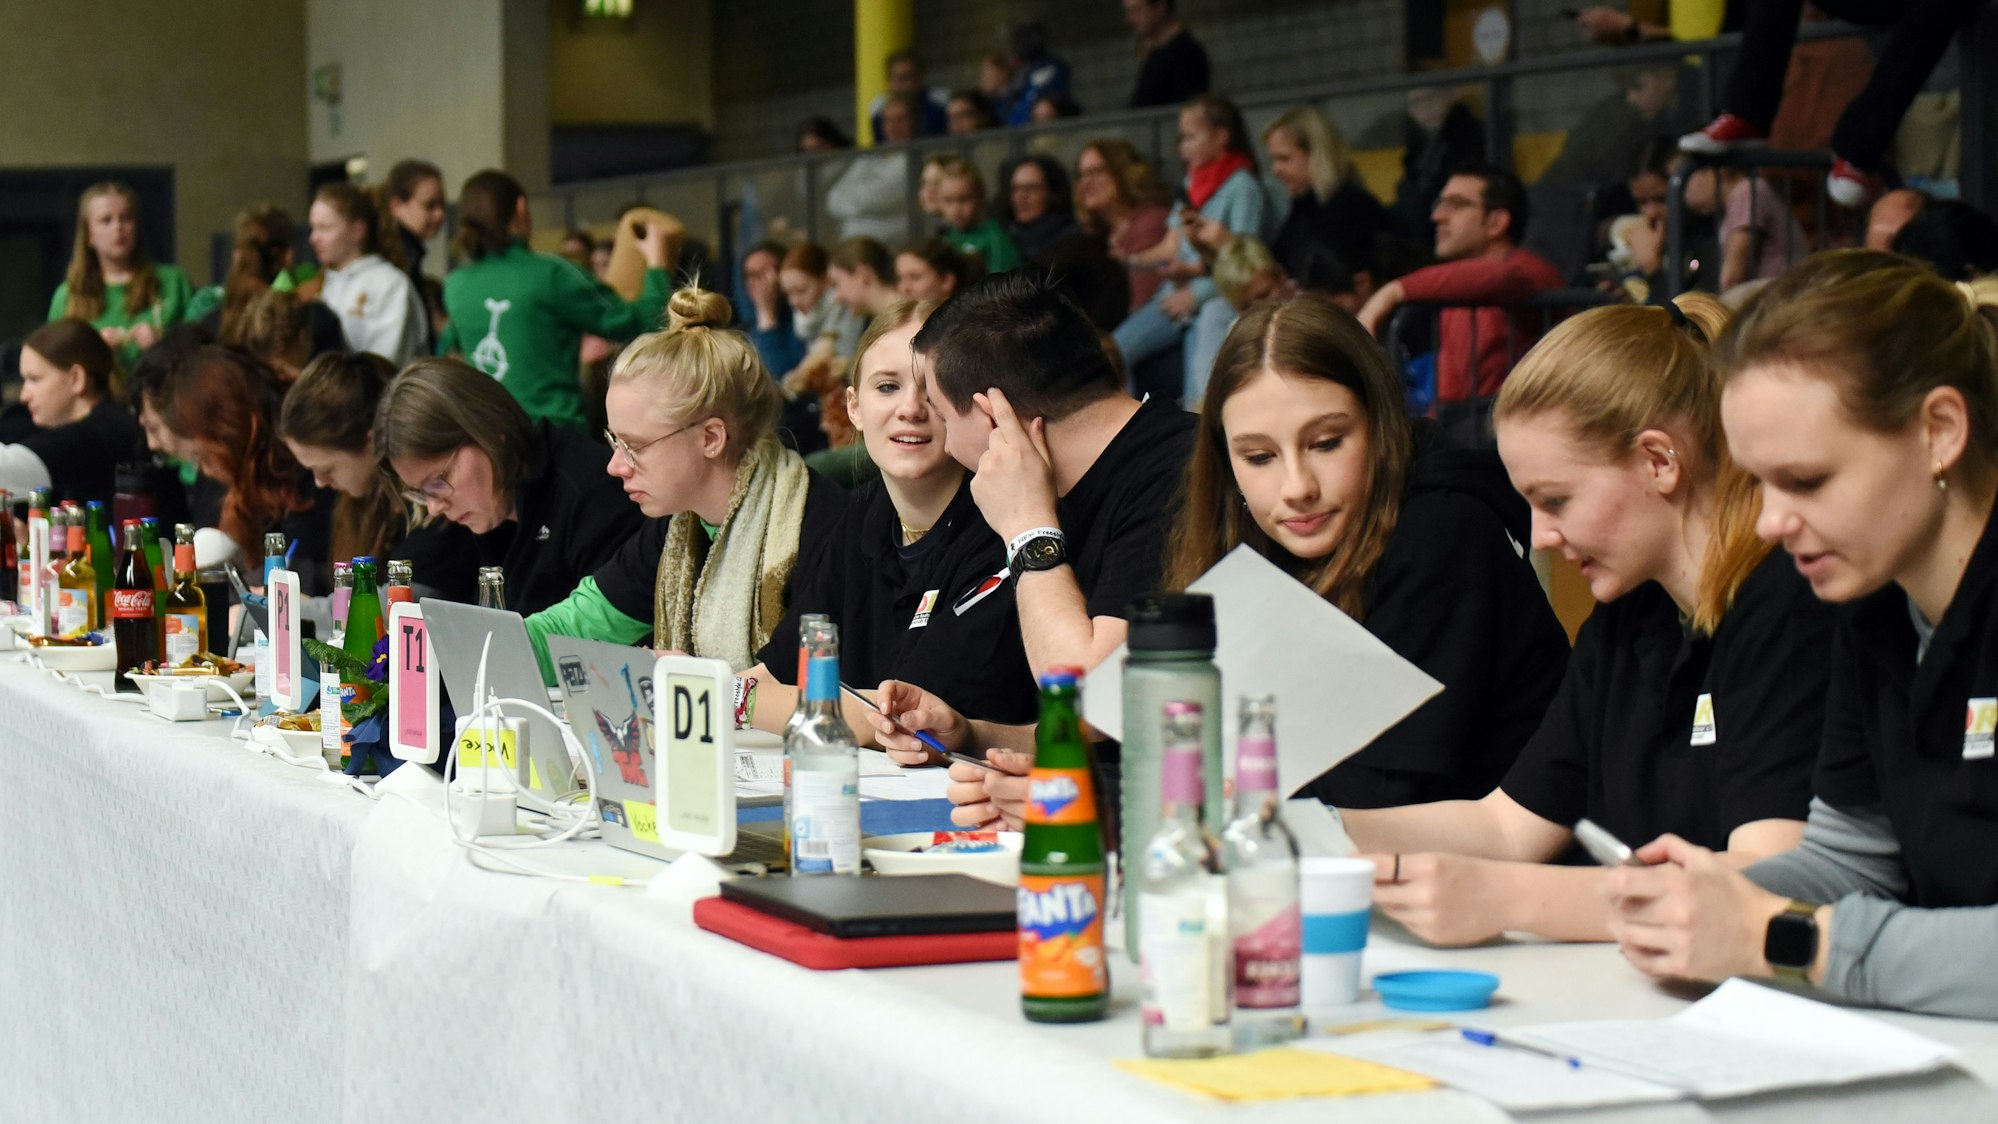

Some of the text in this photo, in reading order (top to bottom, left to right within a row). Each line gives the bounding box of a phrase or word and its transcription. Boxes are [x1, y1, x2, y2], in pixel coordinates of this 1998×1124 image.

[113, 590, 151, 608] Coca-Cola
[277, 589, 290, 632] P1
[403, 625, 425, 673] T1
[340, 686, 358, 697] ANTA
[674, 685, 714, 744] D1
